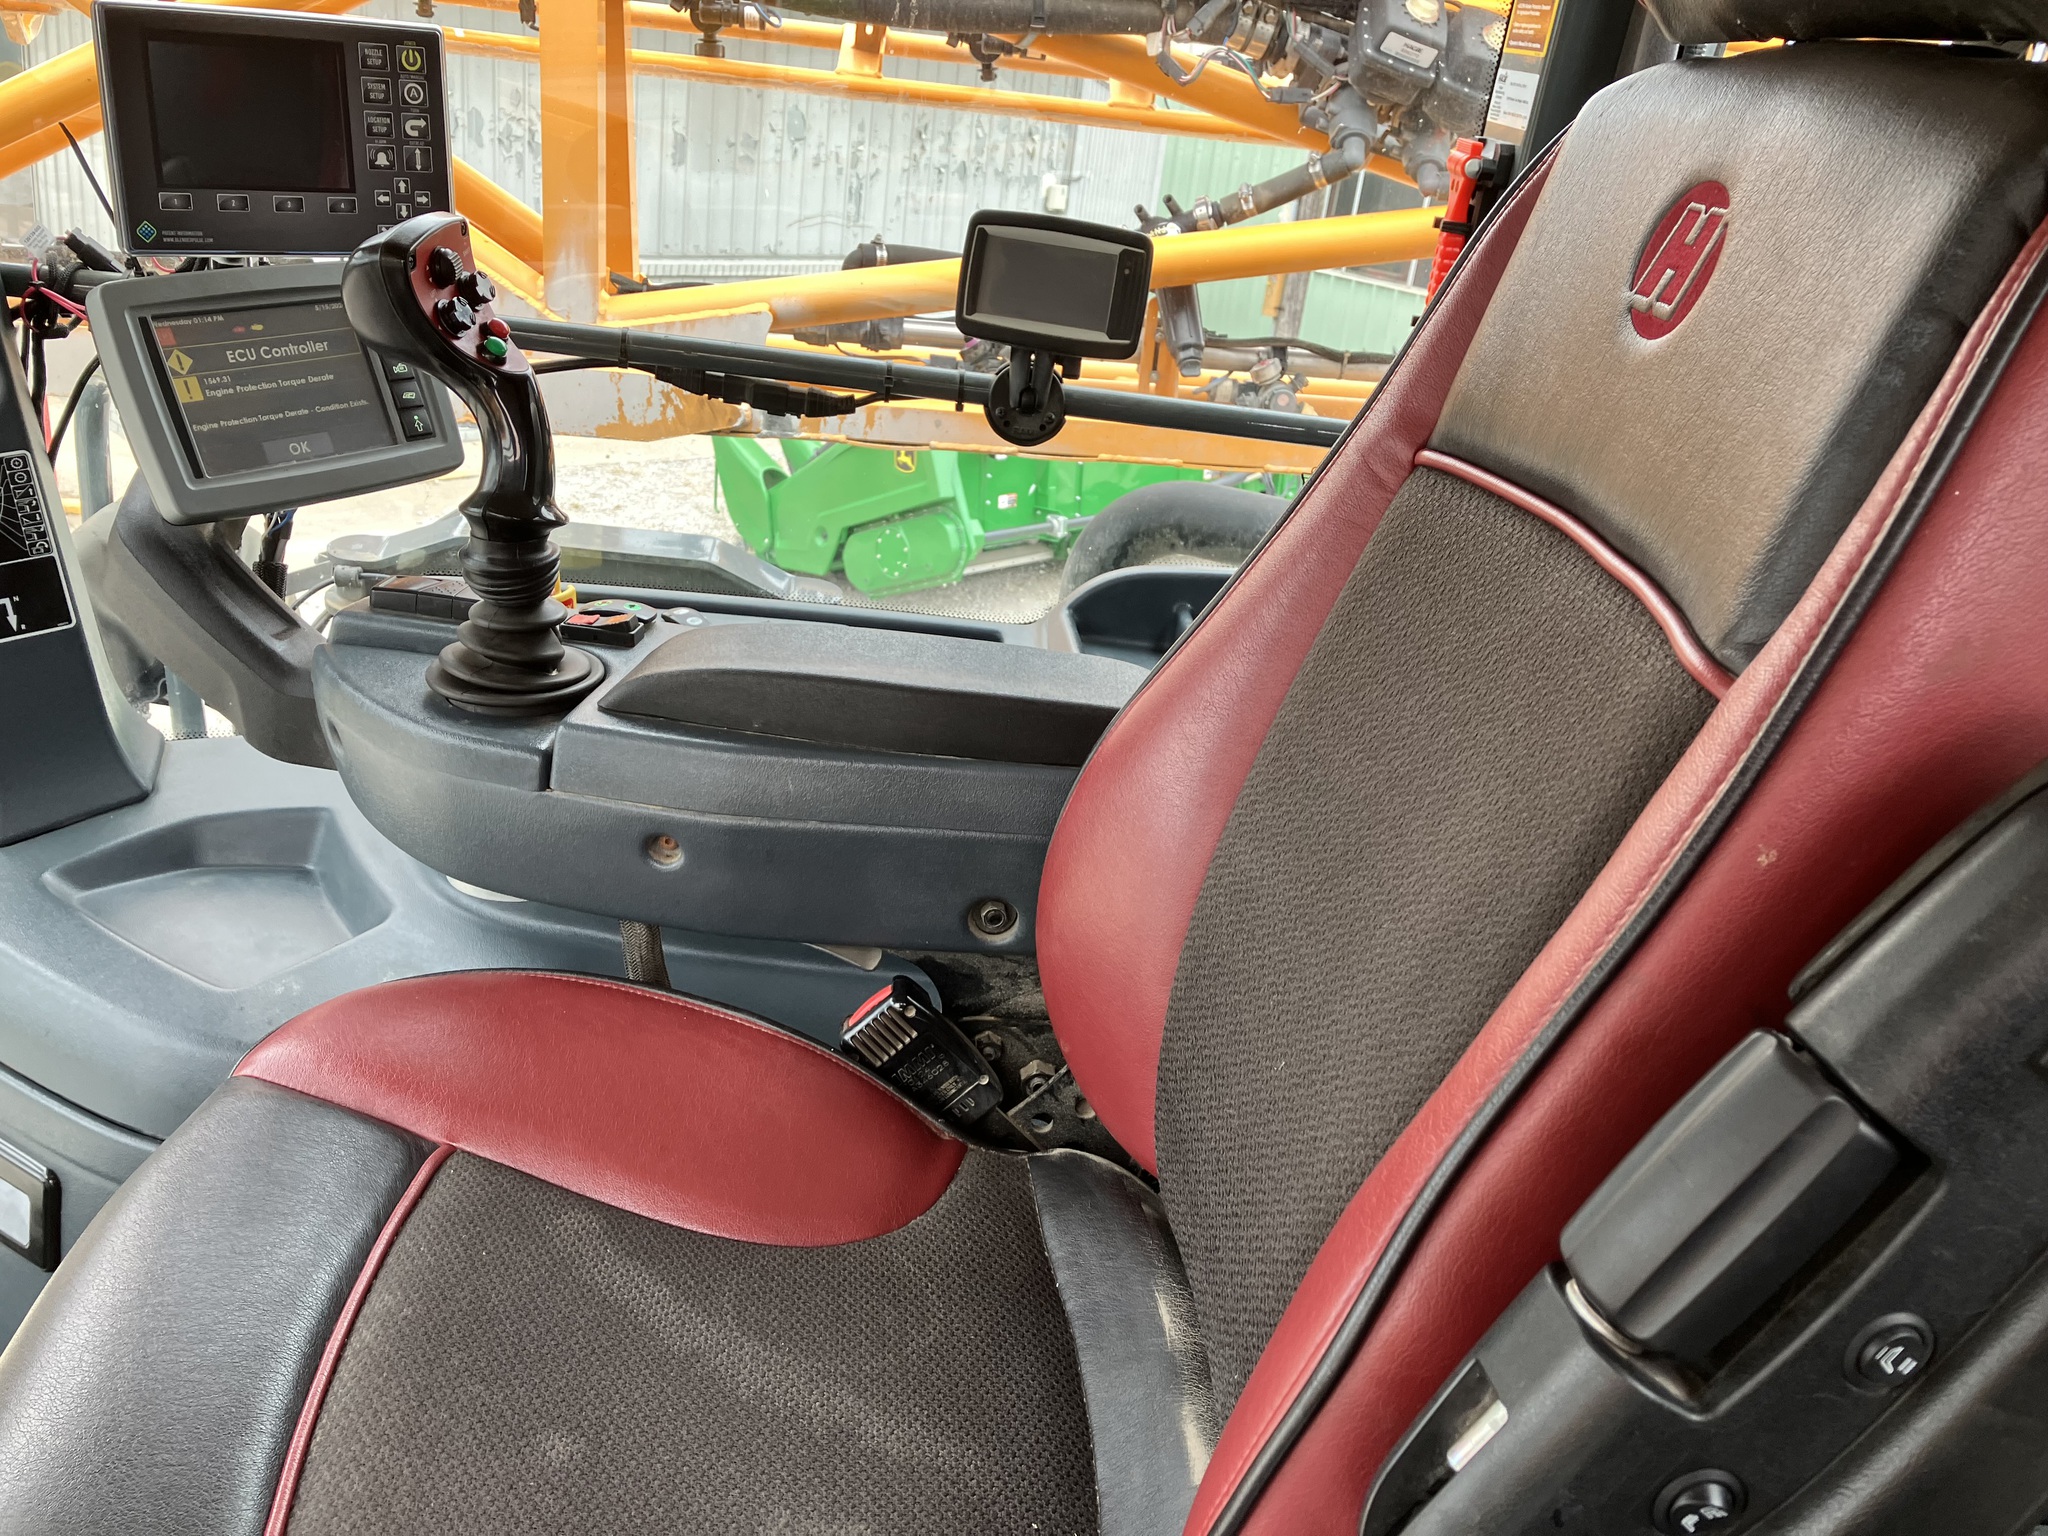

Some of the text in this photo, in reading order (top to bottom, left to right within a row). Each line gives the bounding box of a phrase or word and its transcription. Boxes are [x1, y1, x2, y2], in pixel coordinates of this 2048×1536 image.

[365, 48, 382, 56] NOZZLE
[410, 88, 419, 97] A
[367, 116, 390, 124] LOCATION
[372, 125, 387, 133] SETUP
[193, 316, 212, 325] 01:14
[226, 340, 330, 363] ECU Controller
[203, 375, 231, 385] 1569.31
[205, 372, 334, 398] Engine Protection Torque Derate
[193, 422, 219, 432] Engine
[220, 416, 258, 428] Protection
[258, 411, 284, 422] Torque
[284, 407, 309, 418] Derate
[315, 401, 349, 413] Condition
[289, 441, 311, 455] OK
